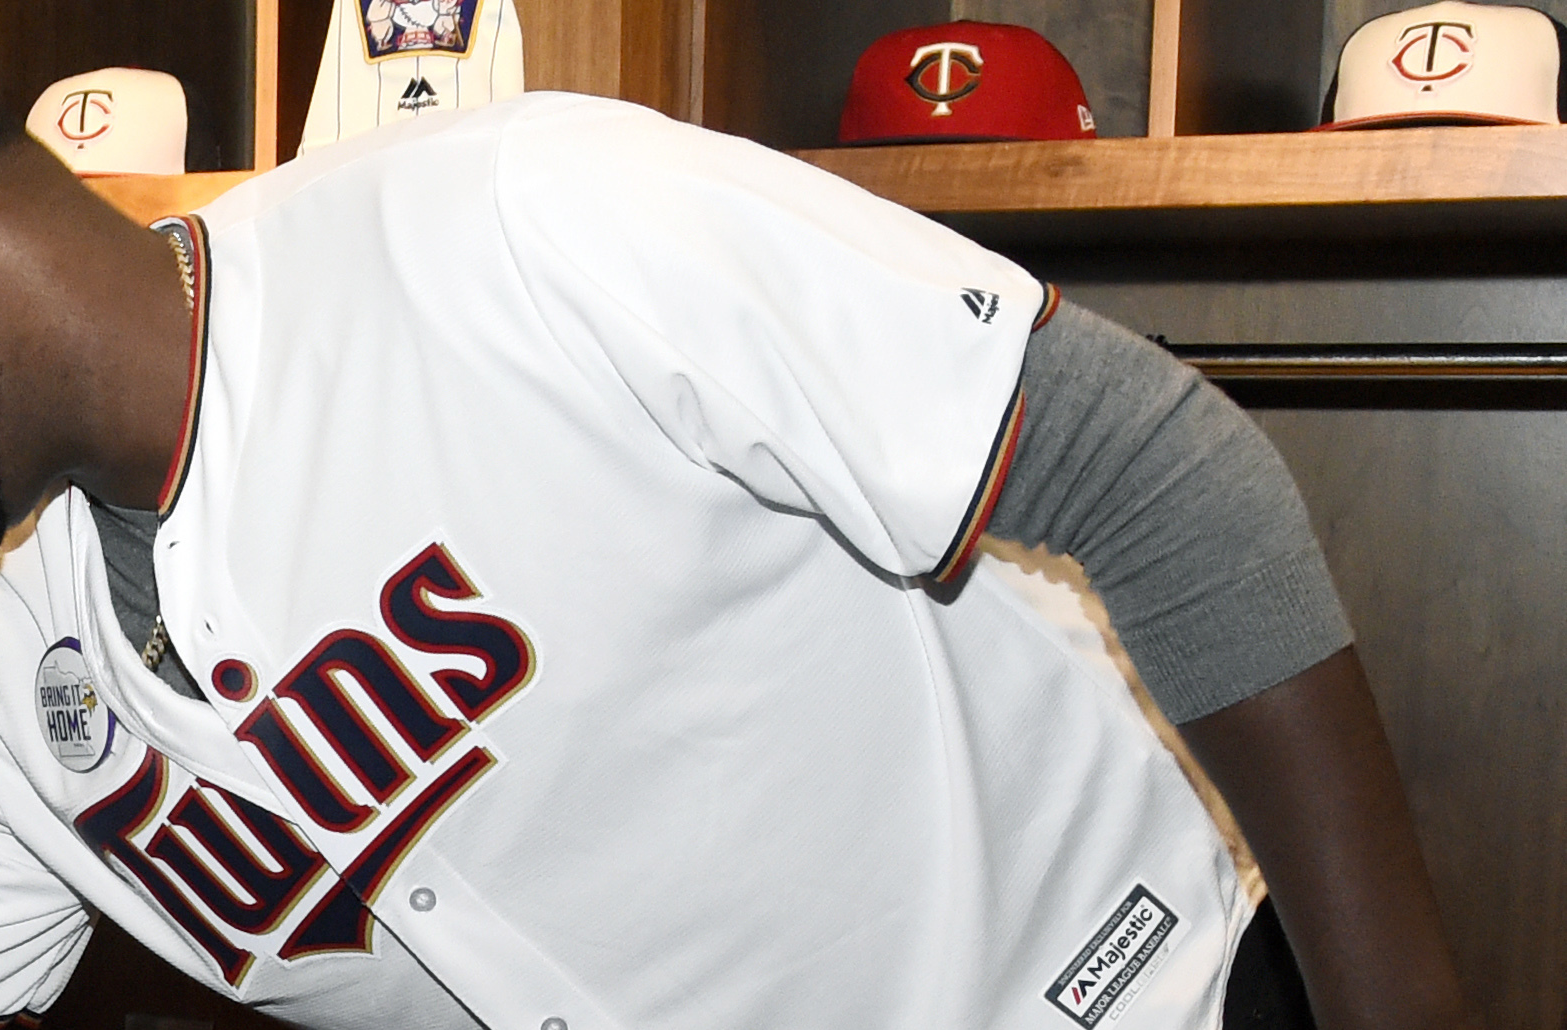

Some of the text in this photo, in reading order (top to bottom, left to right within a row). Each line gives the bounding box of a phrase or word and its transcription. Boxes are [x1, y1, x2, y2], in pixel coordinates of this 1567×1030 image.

[397, 97, 440, 112] Majestic
[904, 42, 984, 116] TC
[40, 684, 82, 708] BRING IT
[46, 708, 92, 743] HOME
[73, 542, 537, 987] Twins
[1086, 910, 1124, 950] EXCLUSIVELY
[1118, 898, 1134, 916] FOR
[1086, 906, 1154, 981] Majestic
[1083, 993, 1113, 1026] MAJOR
[1106, 957, 1141, 997] LEAGUE
[1136, 919, 1172, 963] BASEBALL
